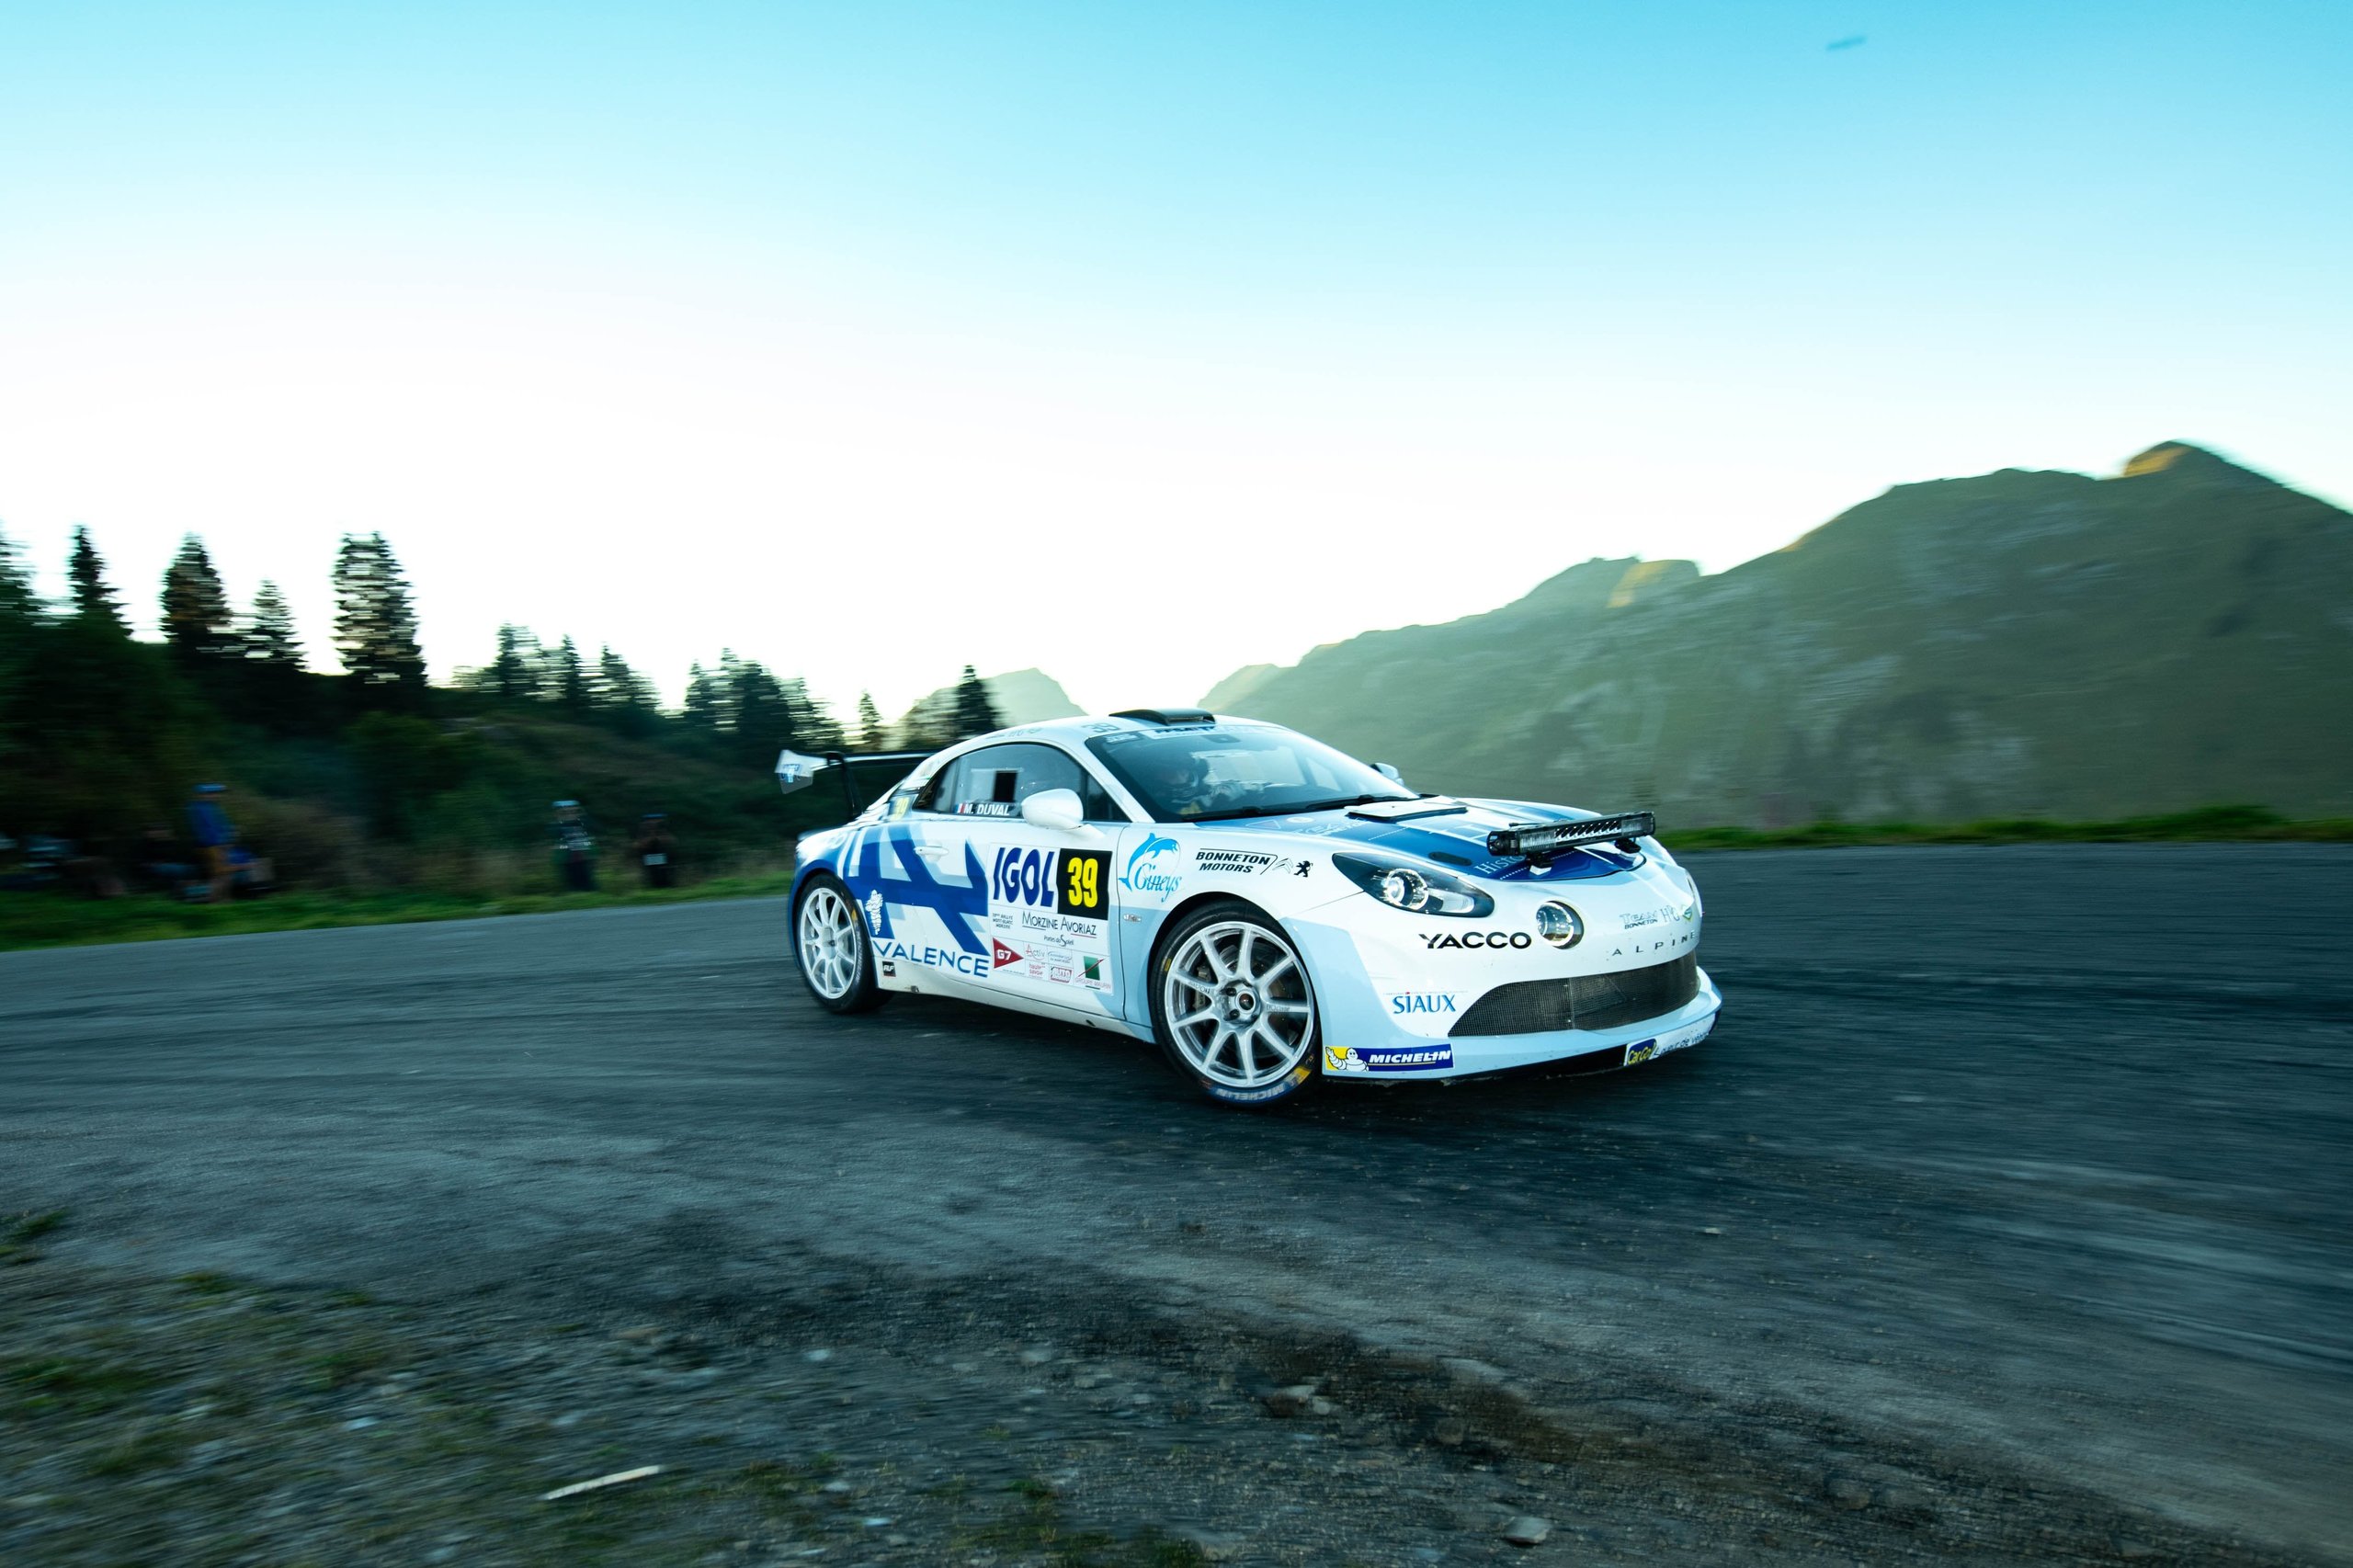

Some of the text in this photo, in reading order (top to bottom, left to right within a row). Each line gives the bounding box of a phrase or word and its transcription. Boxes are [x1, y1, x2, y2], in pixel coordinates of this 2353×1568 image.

[963, 803, 1010, 816] M. DUVAL
[1196, 851, 1270, 866] BONNETON
[1199, 862, 1254, 874] MOTORS
[993, 846, 1055, 908] IGOL
[1067, 857, 1098, 908] 39
[1134, 862, 1183, 903] Gineys
[1418, 931, 1532, 949] YACCO
[1612, 930, 1696, 957] ALPINE
[873, 940, 990, 978] VALENCE
[996, 949, 1011, 960] G7
[1370, 1050, 1451, 1063] MICHELIN
[1216, 1084, 1286, 1101] MICHELIN
